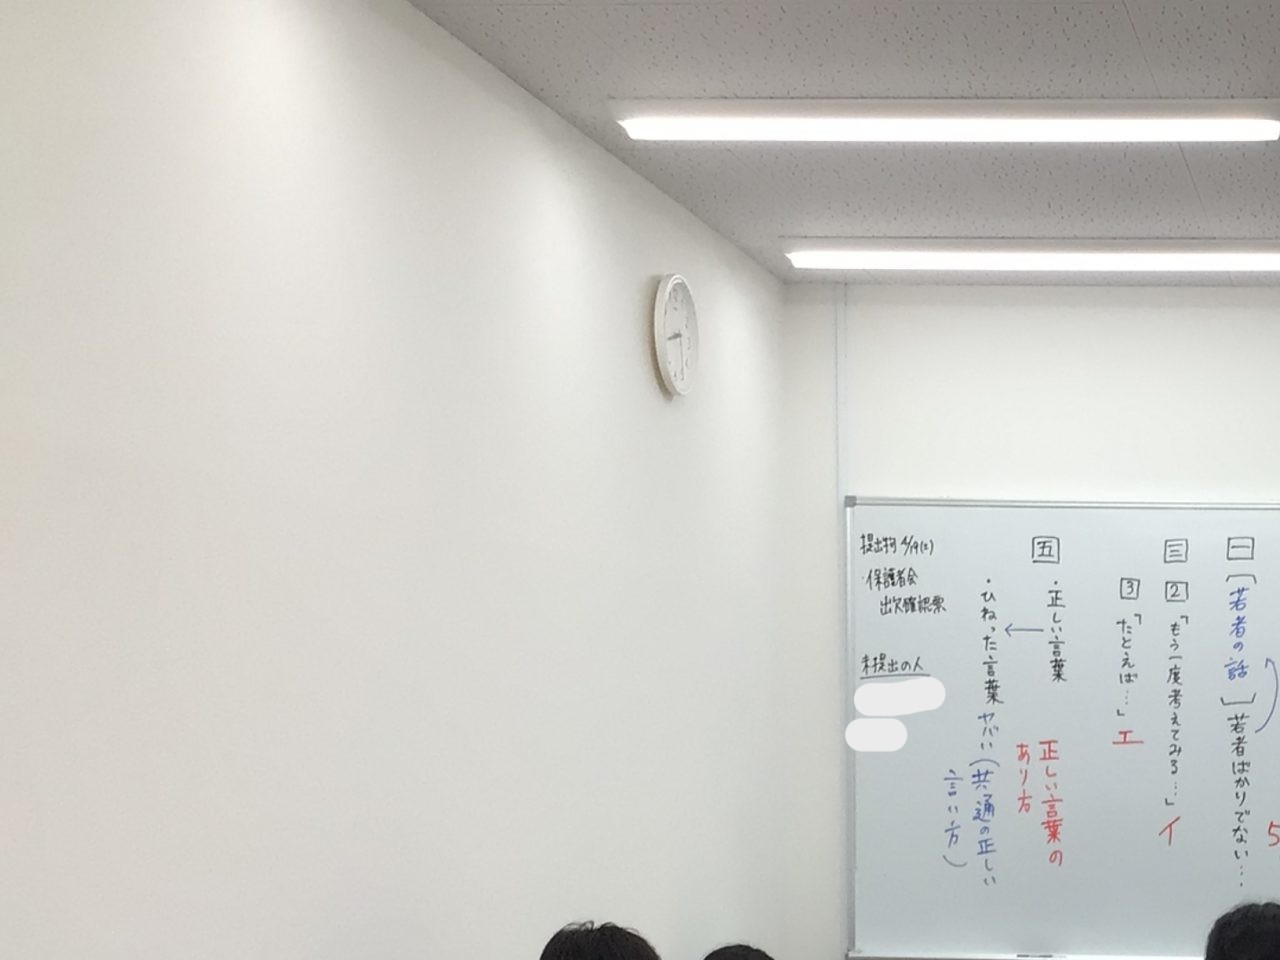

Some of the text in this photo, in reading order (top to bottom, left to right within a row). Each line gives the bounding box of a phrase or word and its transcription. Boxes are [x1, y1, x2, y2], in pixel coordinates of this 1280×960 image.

[1047, 588, 1068, 682] 正しい言葉
[1016, 742, 1033, 814] あり方
[1038, 739, 1064, 867] 正しい言葉の
[1158, 815, 1181, 847] イ
